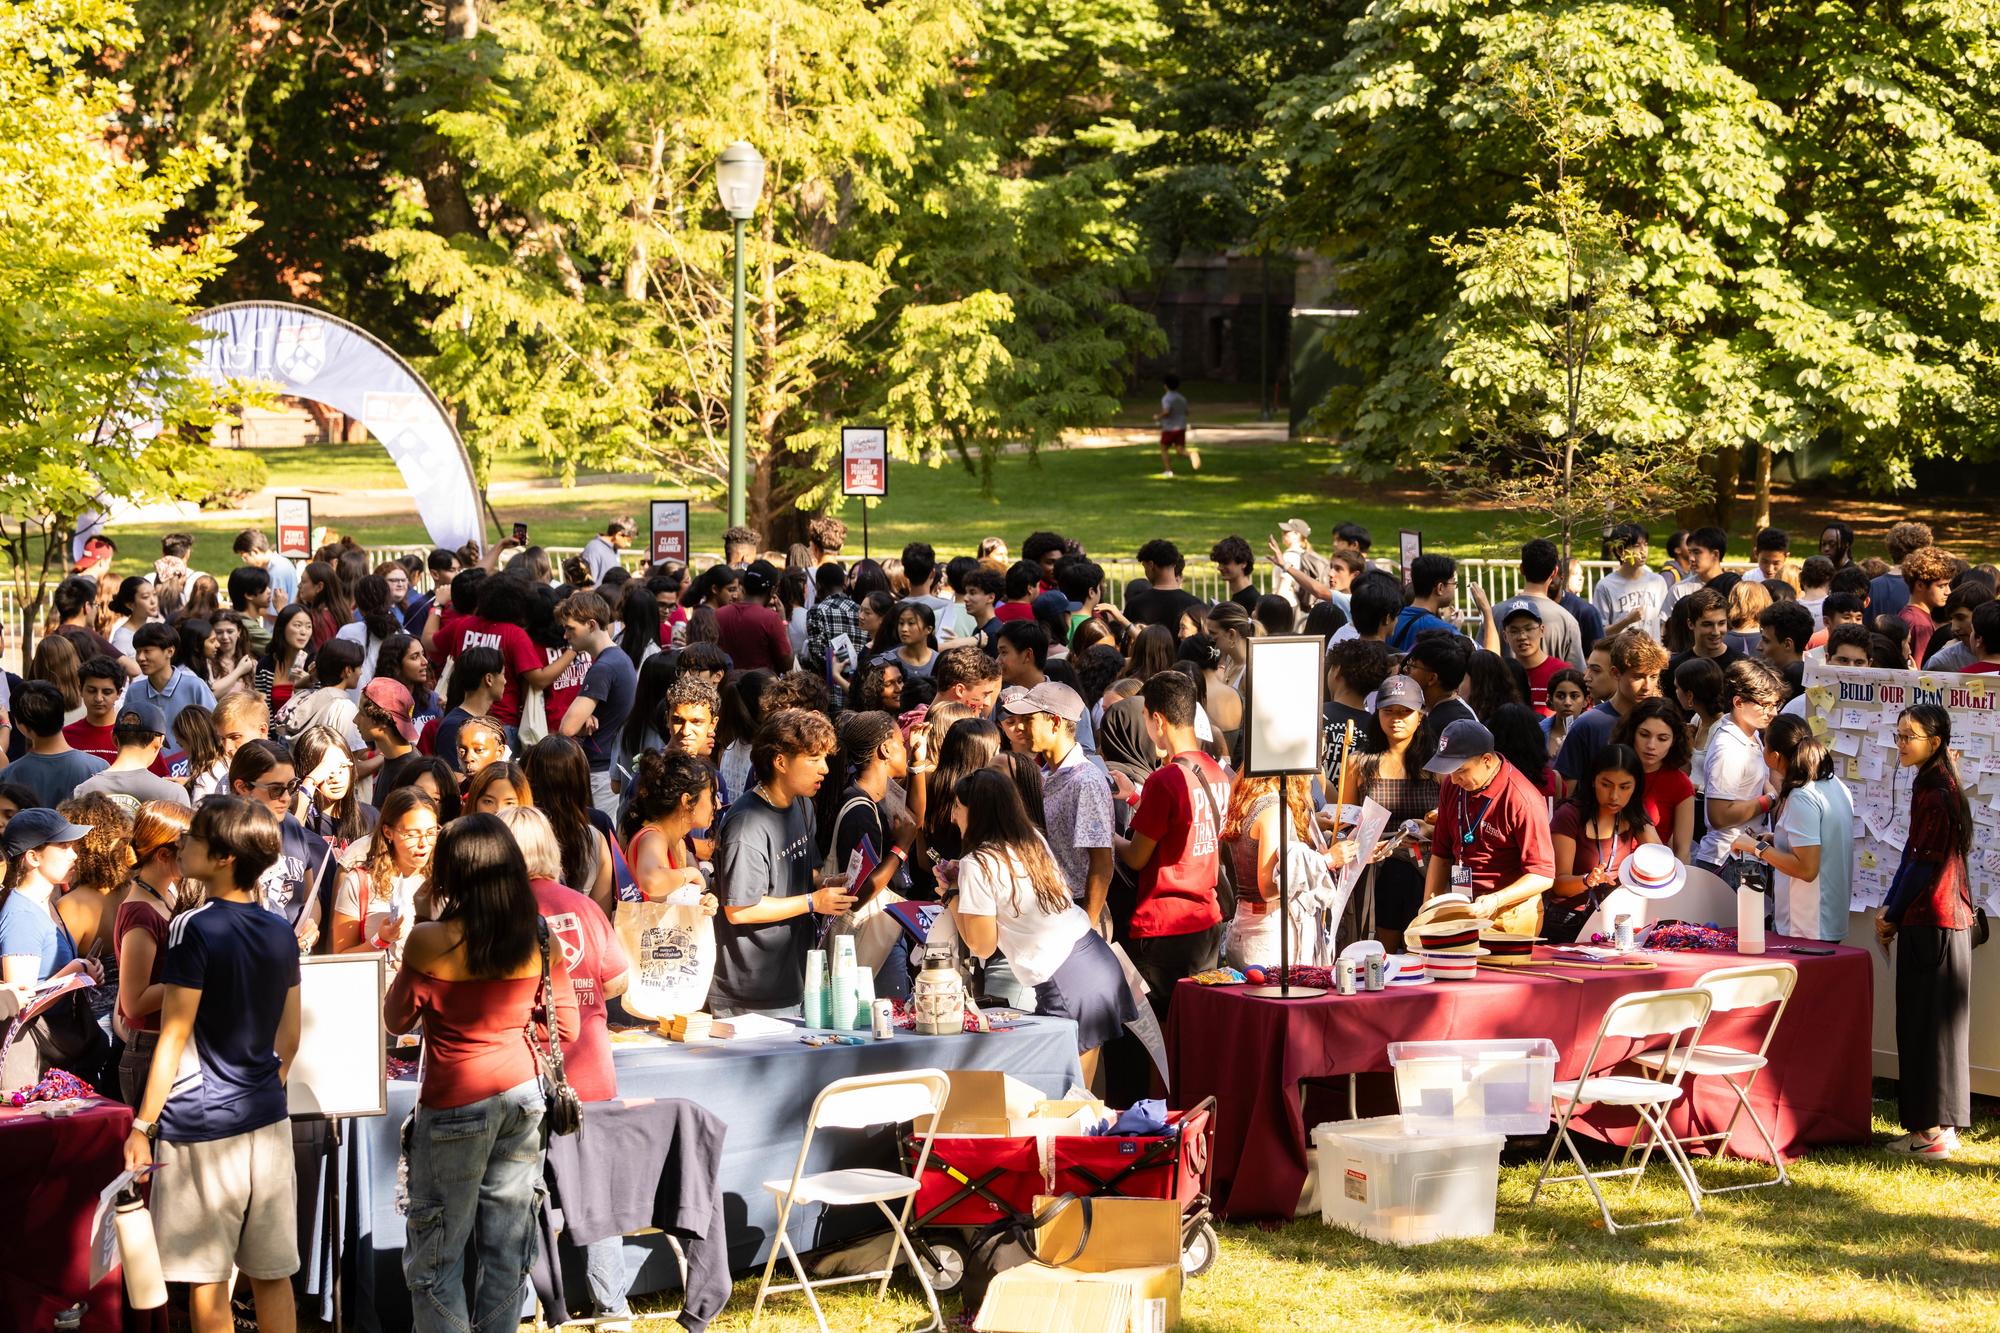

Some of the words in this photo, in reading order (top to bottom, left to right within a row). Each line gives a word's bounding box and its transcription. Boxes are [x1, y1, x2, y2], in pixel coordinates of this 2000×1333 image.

[660, 536, 679, 545] CLASS
[658, 544, 681, 552] BANNER
[1619, 590, 1656, 613] PENN
[1840, 682, 1874, 702] BUILD
[1880, 685, 1904, 703] OUR
[1332, 732, 1358, 746] VAS
[776, 848, 790, 860] LOS
[1453, 869, 1469, 877] EVENT
[1454, 876, 1469, 884] STAFF
[641, 979, 661, 987] PENN
